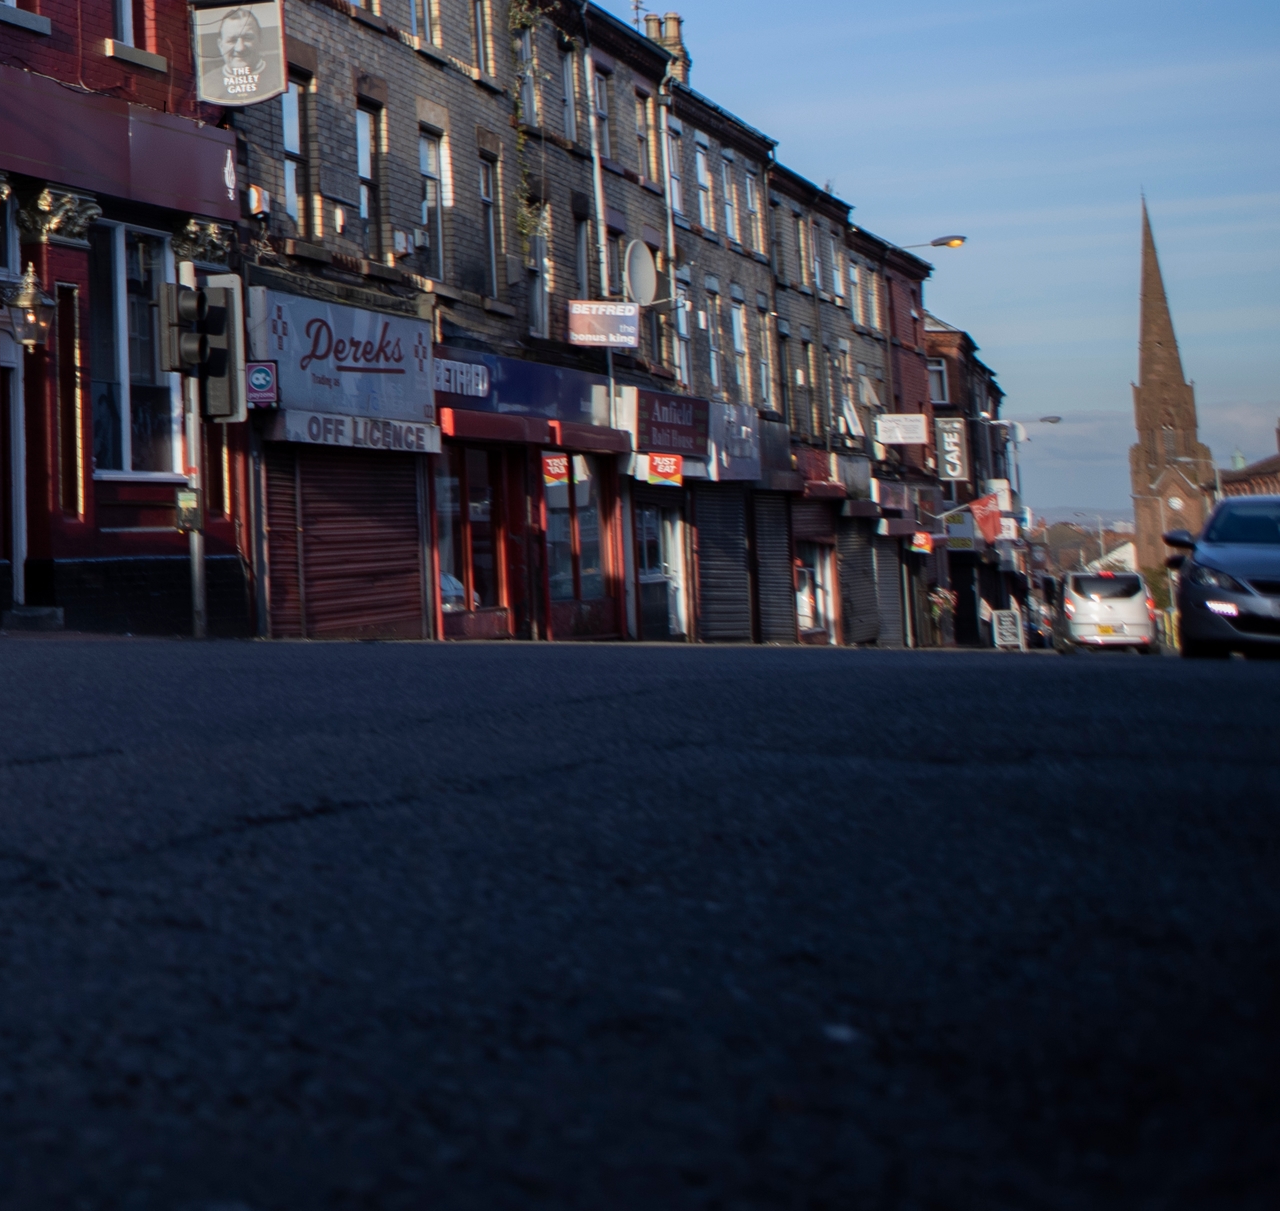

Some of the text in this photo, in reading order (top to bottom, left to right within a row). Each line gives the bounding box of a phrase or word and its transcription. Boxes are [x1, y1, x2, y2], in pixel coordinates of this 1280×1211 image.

[233, 67, 250, 75] THE
[223, 75, 259, 85] PAISLEY
[227, 84, 257, 93] GATES
[570, 304, 635, 316] BETFRED
[620, 324, 636, 333] the
[570, 332, 635, 345] bonus king
[300, 318, 404, 371] Dereks
[651, 399, 693, 426] Anfield
[308, 416, 426, 450] OFF LICENCE
[653, 456, 677, 466] JUST
[656, 464, 677, 474] EAT
